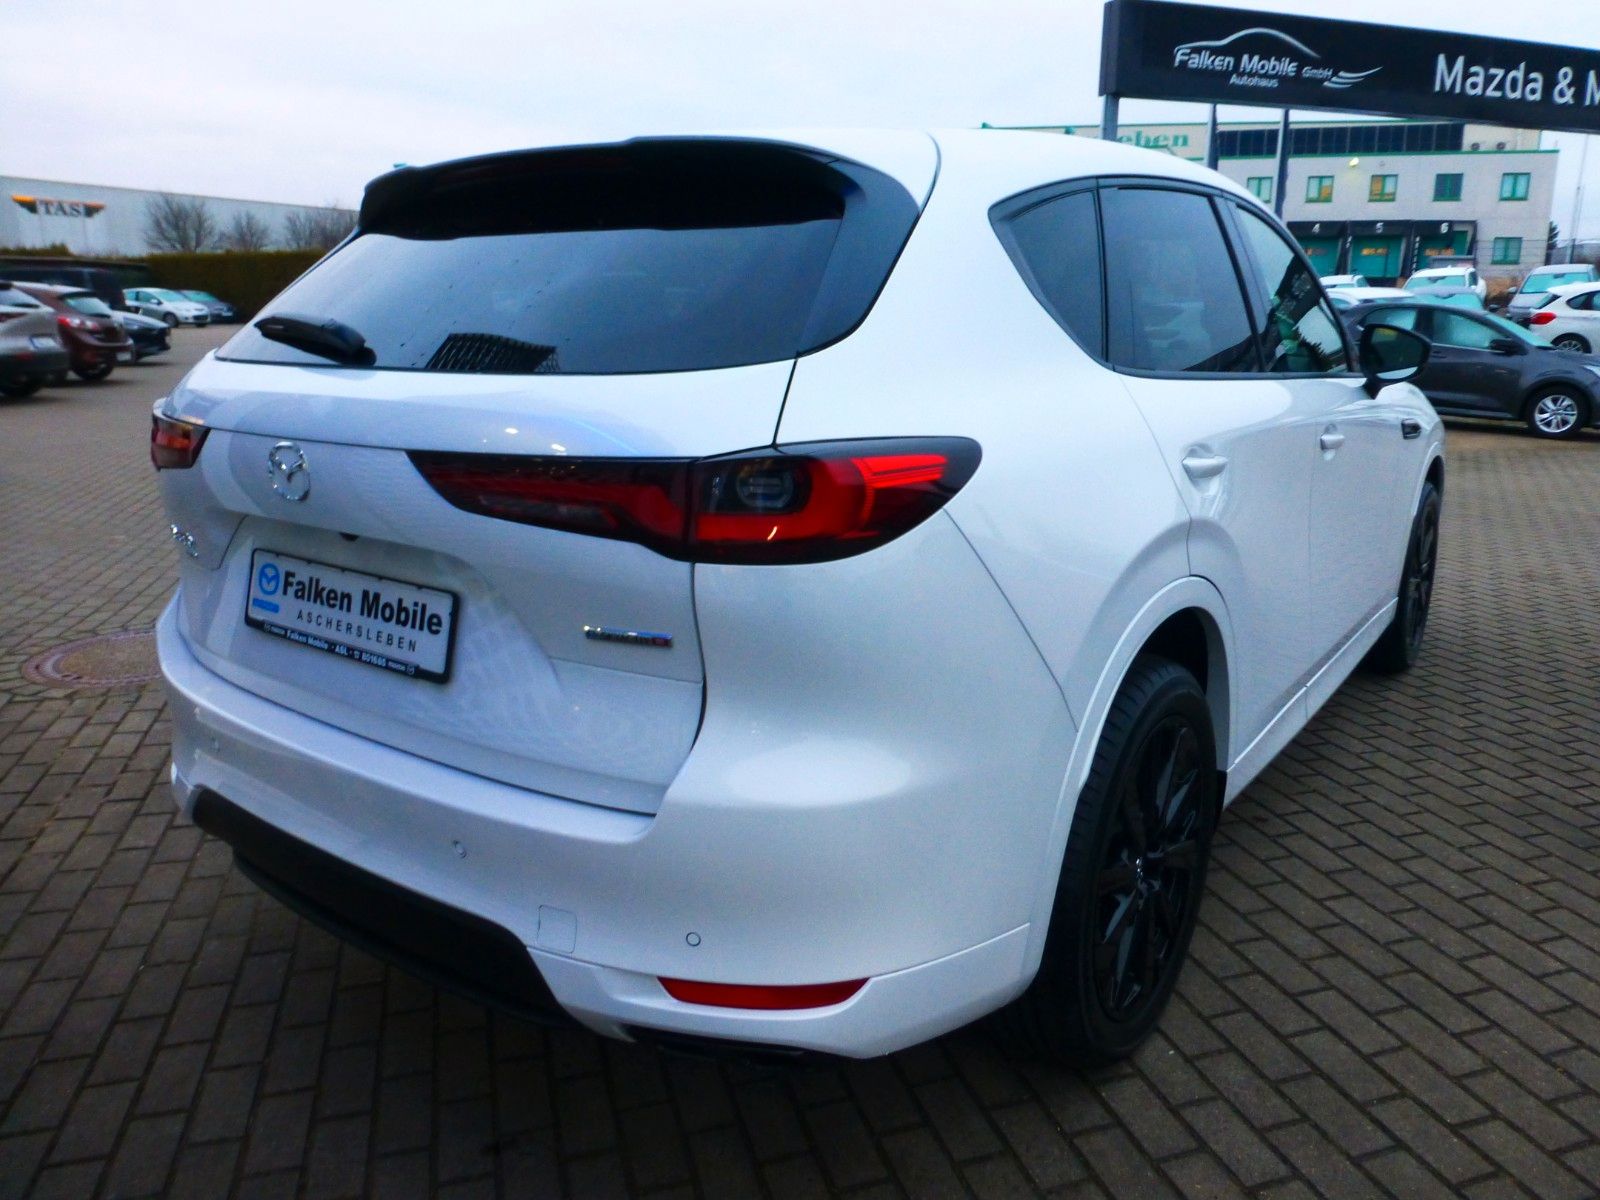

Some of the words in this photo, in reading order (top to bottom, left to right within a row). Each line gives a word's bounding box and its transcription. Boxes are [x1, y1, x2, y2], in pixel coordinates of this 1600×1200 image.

[1174, 48, 1234, 71] Falken
[1239, 53, 1298, 77] Mobile
[1302, 66, 1333, 79] GmbH
[1434, 53, 1544, 101] Mazda
[1553, 66, 1576, 105] &
[1229, 73, 1279, 88] Autohaus
[1311, 223, 1320, 234] 4
[1375, 223, 1384, 233] 5
[282, 570, 352, 613] Falken
[360, 589, 443, 635] Mobile
[296, 609, 417, 652] ASCHERSLEBEN
